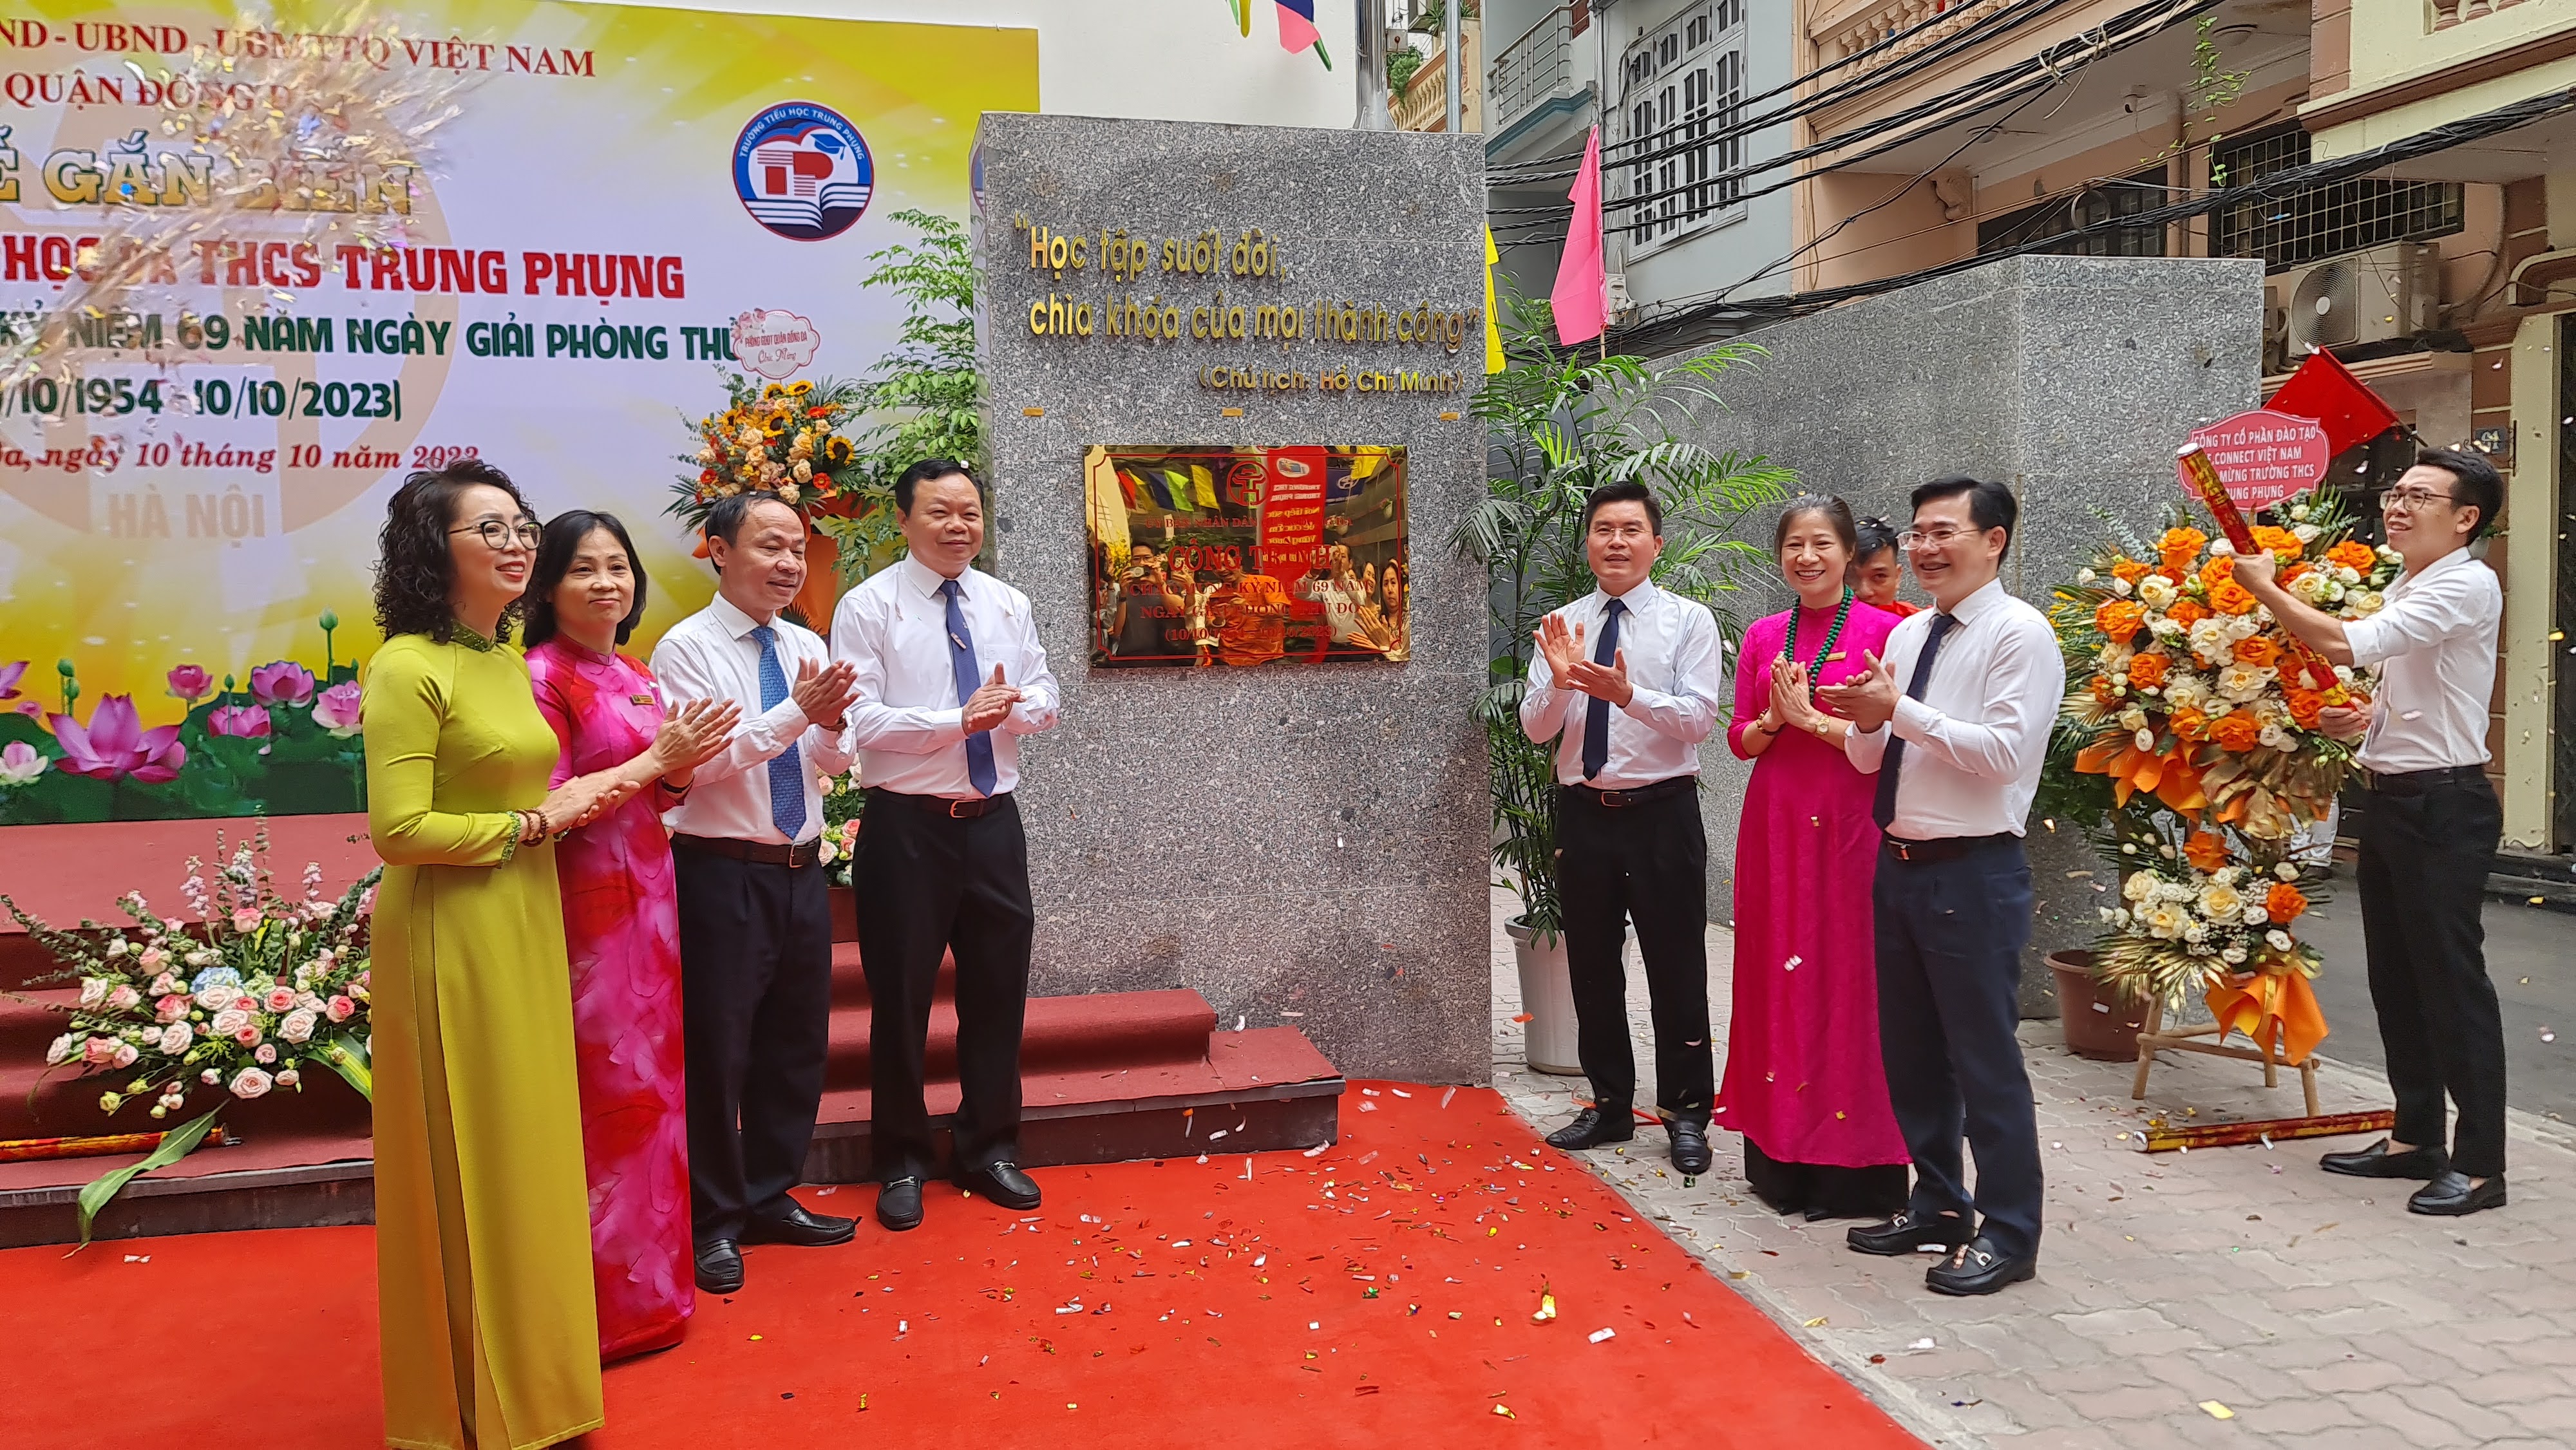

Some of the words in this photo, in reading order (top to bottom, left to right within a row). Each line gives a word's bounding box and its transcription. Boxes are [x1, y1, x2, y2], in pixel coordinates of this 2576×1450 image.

[75, 23, 187, 53] UBND
[401, 37, 495, 75] VIỆT
[506, 45, 596, 77] NAM
[5, 69, 124, 110] QUẬN
[812, 109, 844, 131] TRUNG
[43, 129, 215, 207] GẮN
[1100, 227, 1148, 282] tập
[1161, 225, 1222, 274] suốt
[1231, 227, 1287, 284] đời,
[198, 240, 323, 288] THCS
[336, 244, 508, 294] TRUNG
[522, 251, 685, 306] PHỤNG
[178, 308, 230, 350] 69
[346, 312, 452, 355] NGÀY
[466, 312, 533, 357] GIẢI
[547, 317, 668, 361] PHÒNG
[1030, 292, 1094, 335] chìa
[1105, 293, 1180, 339] khóa
[1191, 290, 1245, 339] của
[1253, 304, 1305, 351] mọi
[1313, 298, 1390, 343] thành
[1319, 363, 1350, 391] Hồ
[2221, 434, 2231, 447] TY
[2276, 424, 2297, 442] ĐÀO
[2299, 426, 2316, 442] TẠO
[135, 442, 170, 467] 10
[180, 442, 275, 473] tháng
[288, 444, 321, 468] 10
[332, 446, 402, 469] năm
[2257, 446, 2278, 464] VIỆT
[2280, 446, 2303, 460] NAM
[2219, 466, 2248, 483] MỪNG
[2249, 464, 2290, 481] TRƯỜNG
[2292, 463, 2315, 478] THCS
[2251, 484, 2284, 502] PHỤNG
[106, 483, 173, 540] HÀ
[184, 483, 265, 548] NỘI
[1168, 538, 1243, 572] CÔNG
[1239, 577, 1262, 594] KỶ
[1312, 581, 1329, 592] 69
